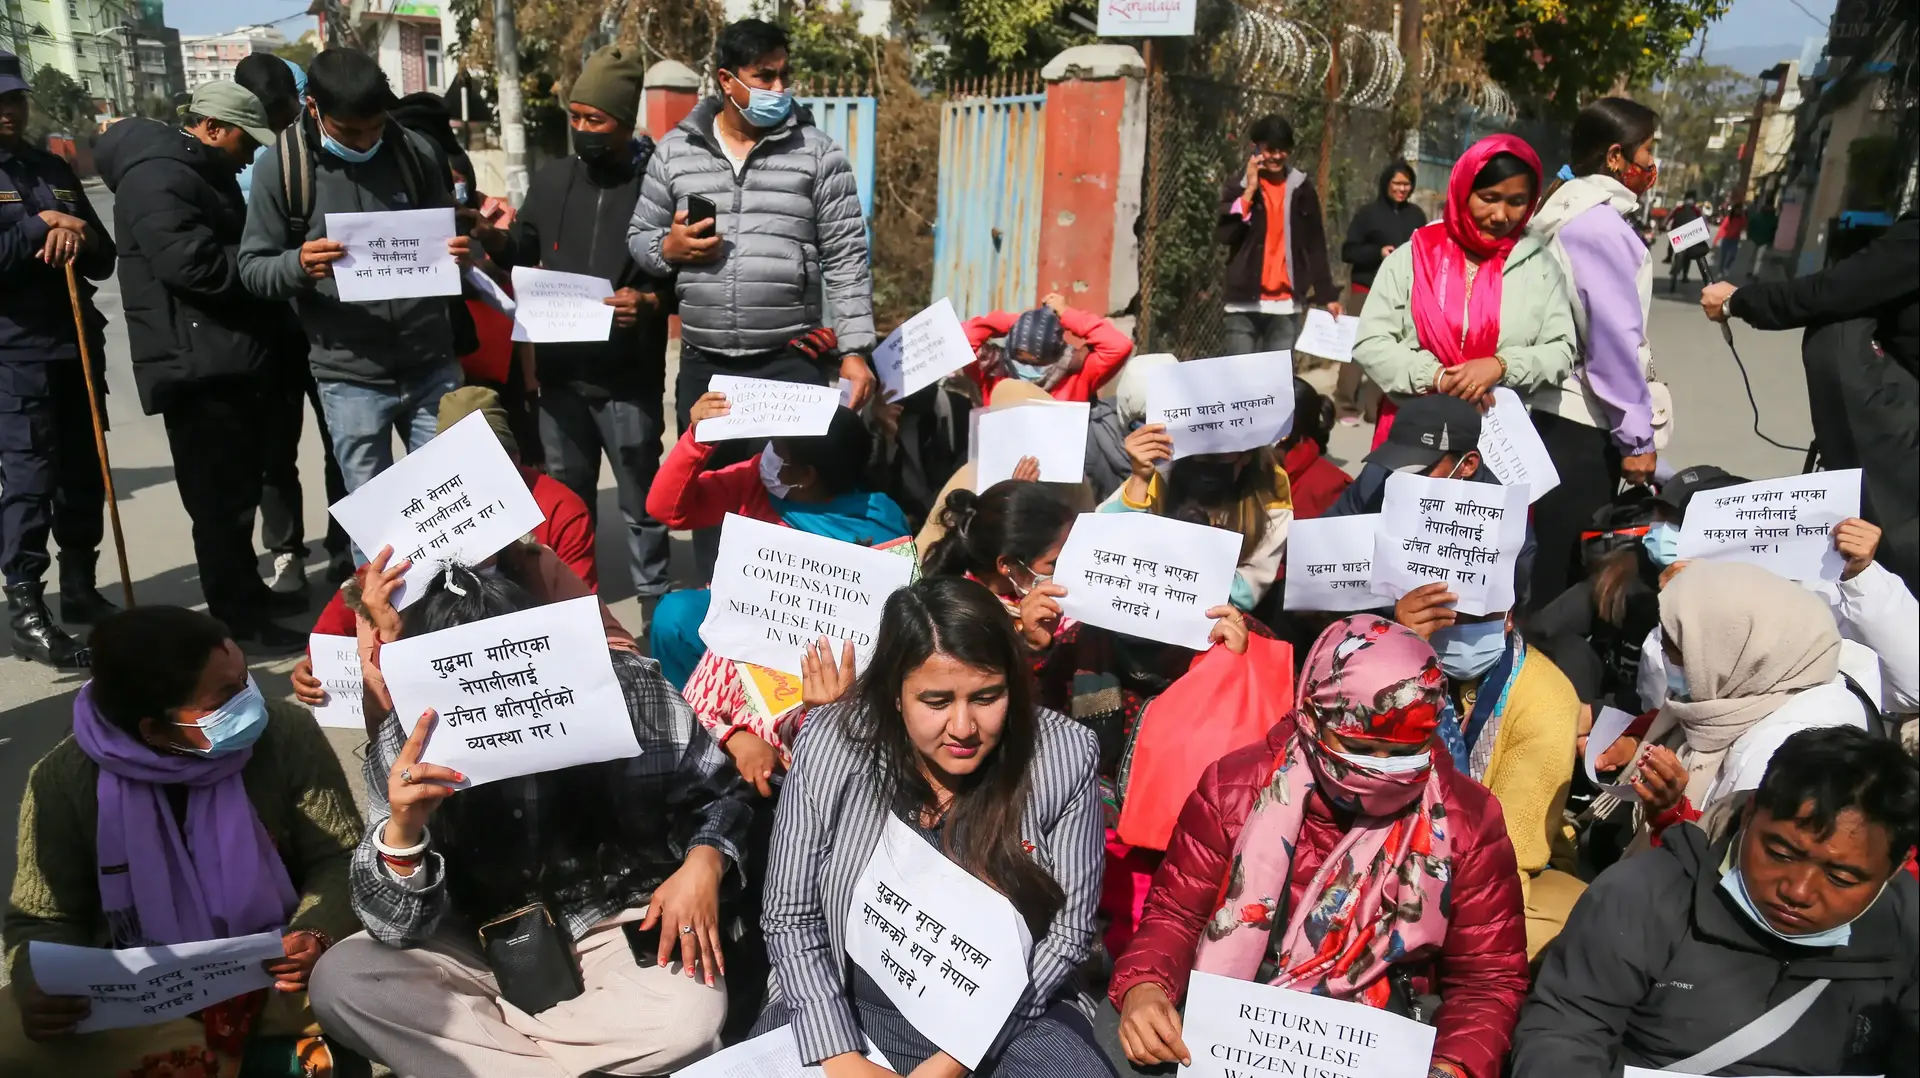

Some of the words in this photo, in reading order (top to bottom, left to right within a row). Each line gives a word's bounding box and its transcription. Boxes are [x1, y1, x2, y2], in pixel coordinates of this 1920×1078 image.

[368, 238, 386, 249] रुसी
[391, 237, 420, 248] सेनामा
[372, 250, 418, 262] नेपालीलाई
[355, 266, 373, 278] भर्ना
[378, 266, 391, 277] गर्न
[396, 266, 414, 276] बन्द
[418, 266, 430, 275] गर
[1163, 407, 1191, 422] युद्धमा
[1197, 401, 1225, 416] घाइते
[1231, 395, 1275, 411] भएकाको
[1188, 421, 1224, 433] उपचार
[1230, 418, 1244, 428] गर
[1487, 412, 1513, 452] TREAT
[1511, 455, 1529, 482] THE
[401, 498, 425, 519] रुसी
[427, 474, 463, 502] सेनामा
[1420, 498, 1445, 514] युद्धमा
[1455, 500, 1504, 520] मारिएका
[1715, 495, 1745, 509] युद्धमा
[1752, 490, 1783, 502] प्रयोग
[1790, 489, 1827, 502] भएका
[416, 492, 472, 534] नेपालीलाई
[1736, 505, 1797, 521] नेपालीलाई
[429, 530, 449, 550] गर्न
[452, 517, 476, 536] बन्द
[478, 504, 496, 520] गर
[1425, 517, 1484, 542] नेपालीलाई
[1703, 528, 1748, 543] सकुशल
[1754, 526, 1790, 539] नेपाल
[1796, 523, 1830, 536] फिर्ता
[1403, 537, 1431, 554] उचित
[1437, 543, 1500, 566] क्षतिपूर्तिको
[1750, 544, 1768, 553] गर
[758, 547, 797, 567] GIVE
[801, 558, 861, 584] PROPER
[1094, 549, 1126, 565] युद्धमा
[1133, 557, 1158, 577] मृत्यु
[1165, 565, 1199, 582] भएका
[1307, 564, 1337, 576] युद्धमा
[1342, 559, 1371, 572] घाइते
[1407, 561, 1450, 580] व्यवस्था
[1456, 571, 1475, 583] गर
[743, 564, 871, 605] COMPENSATION
[1085, 570, 1132, 590] मृतकको
[1138, 582, 1158, 596] शव
[1165, 585, 1198, 605] नेपाल
[1330, 580, 1367, 589] उपचार
[770, 590, 800, 608] FOR
[807, 598, 838, 617] THE
[1112, 596, 1150, 617] लेराइदे
[729, 600, 809, 630] NEPALESE
[814, 620, 870, 646] KILLED
[766, 628, 782, 642] IN
[431, 652, 473, 678] युद्धमा
[484, 636, 550, 662] मारिएका
[459, 663, 538, 695] नेपालीलाई
[444, 706, 487, 727] उचित
[494, 686, 574, 719] क्षतिपूर्तिको
[466, 730, 523, 750] व्यवस्था
[529, 724, 553, 739] गर
[876, 881, 912, 914] युद्धमा
[916, 910, 946, 943] मृत्यु
[951, 934, 991, 969] भएका
[864, 902, 907, 946] मृतकको
[910, 942, 936, 967] शव
[940, 959, 979, 996] नेपाल
[146, 969, 184, 987] मृत्यु
[202, 965, 247, 980] नेपाल
[881, 949, 917, 990] लेराइदे
[1239, 1004, 1328, 1036] RETURN
[1336, 1024, 1379, 1049] THE
[1211, 1043, 1296, 1075] CITIZEN
[1249, 1028, 1360, 1069] NEPALESE
